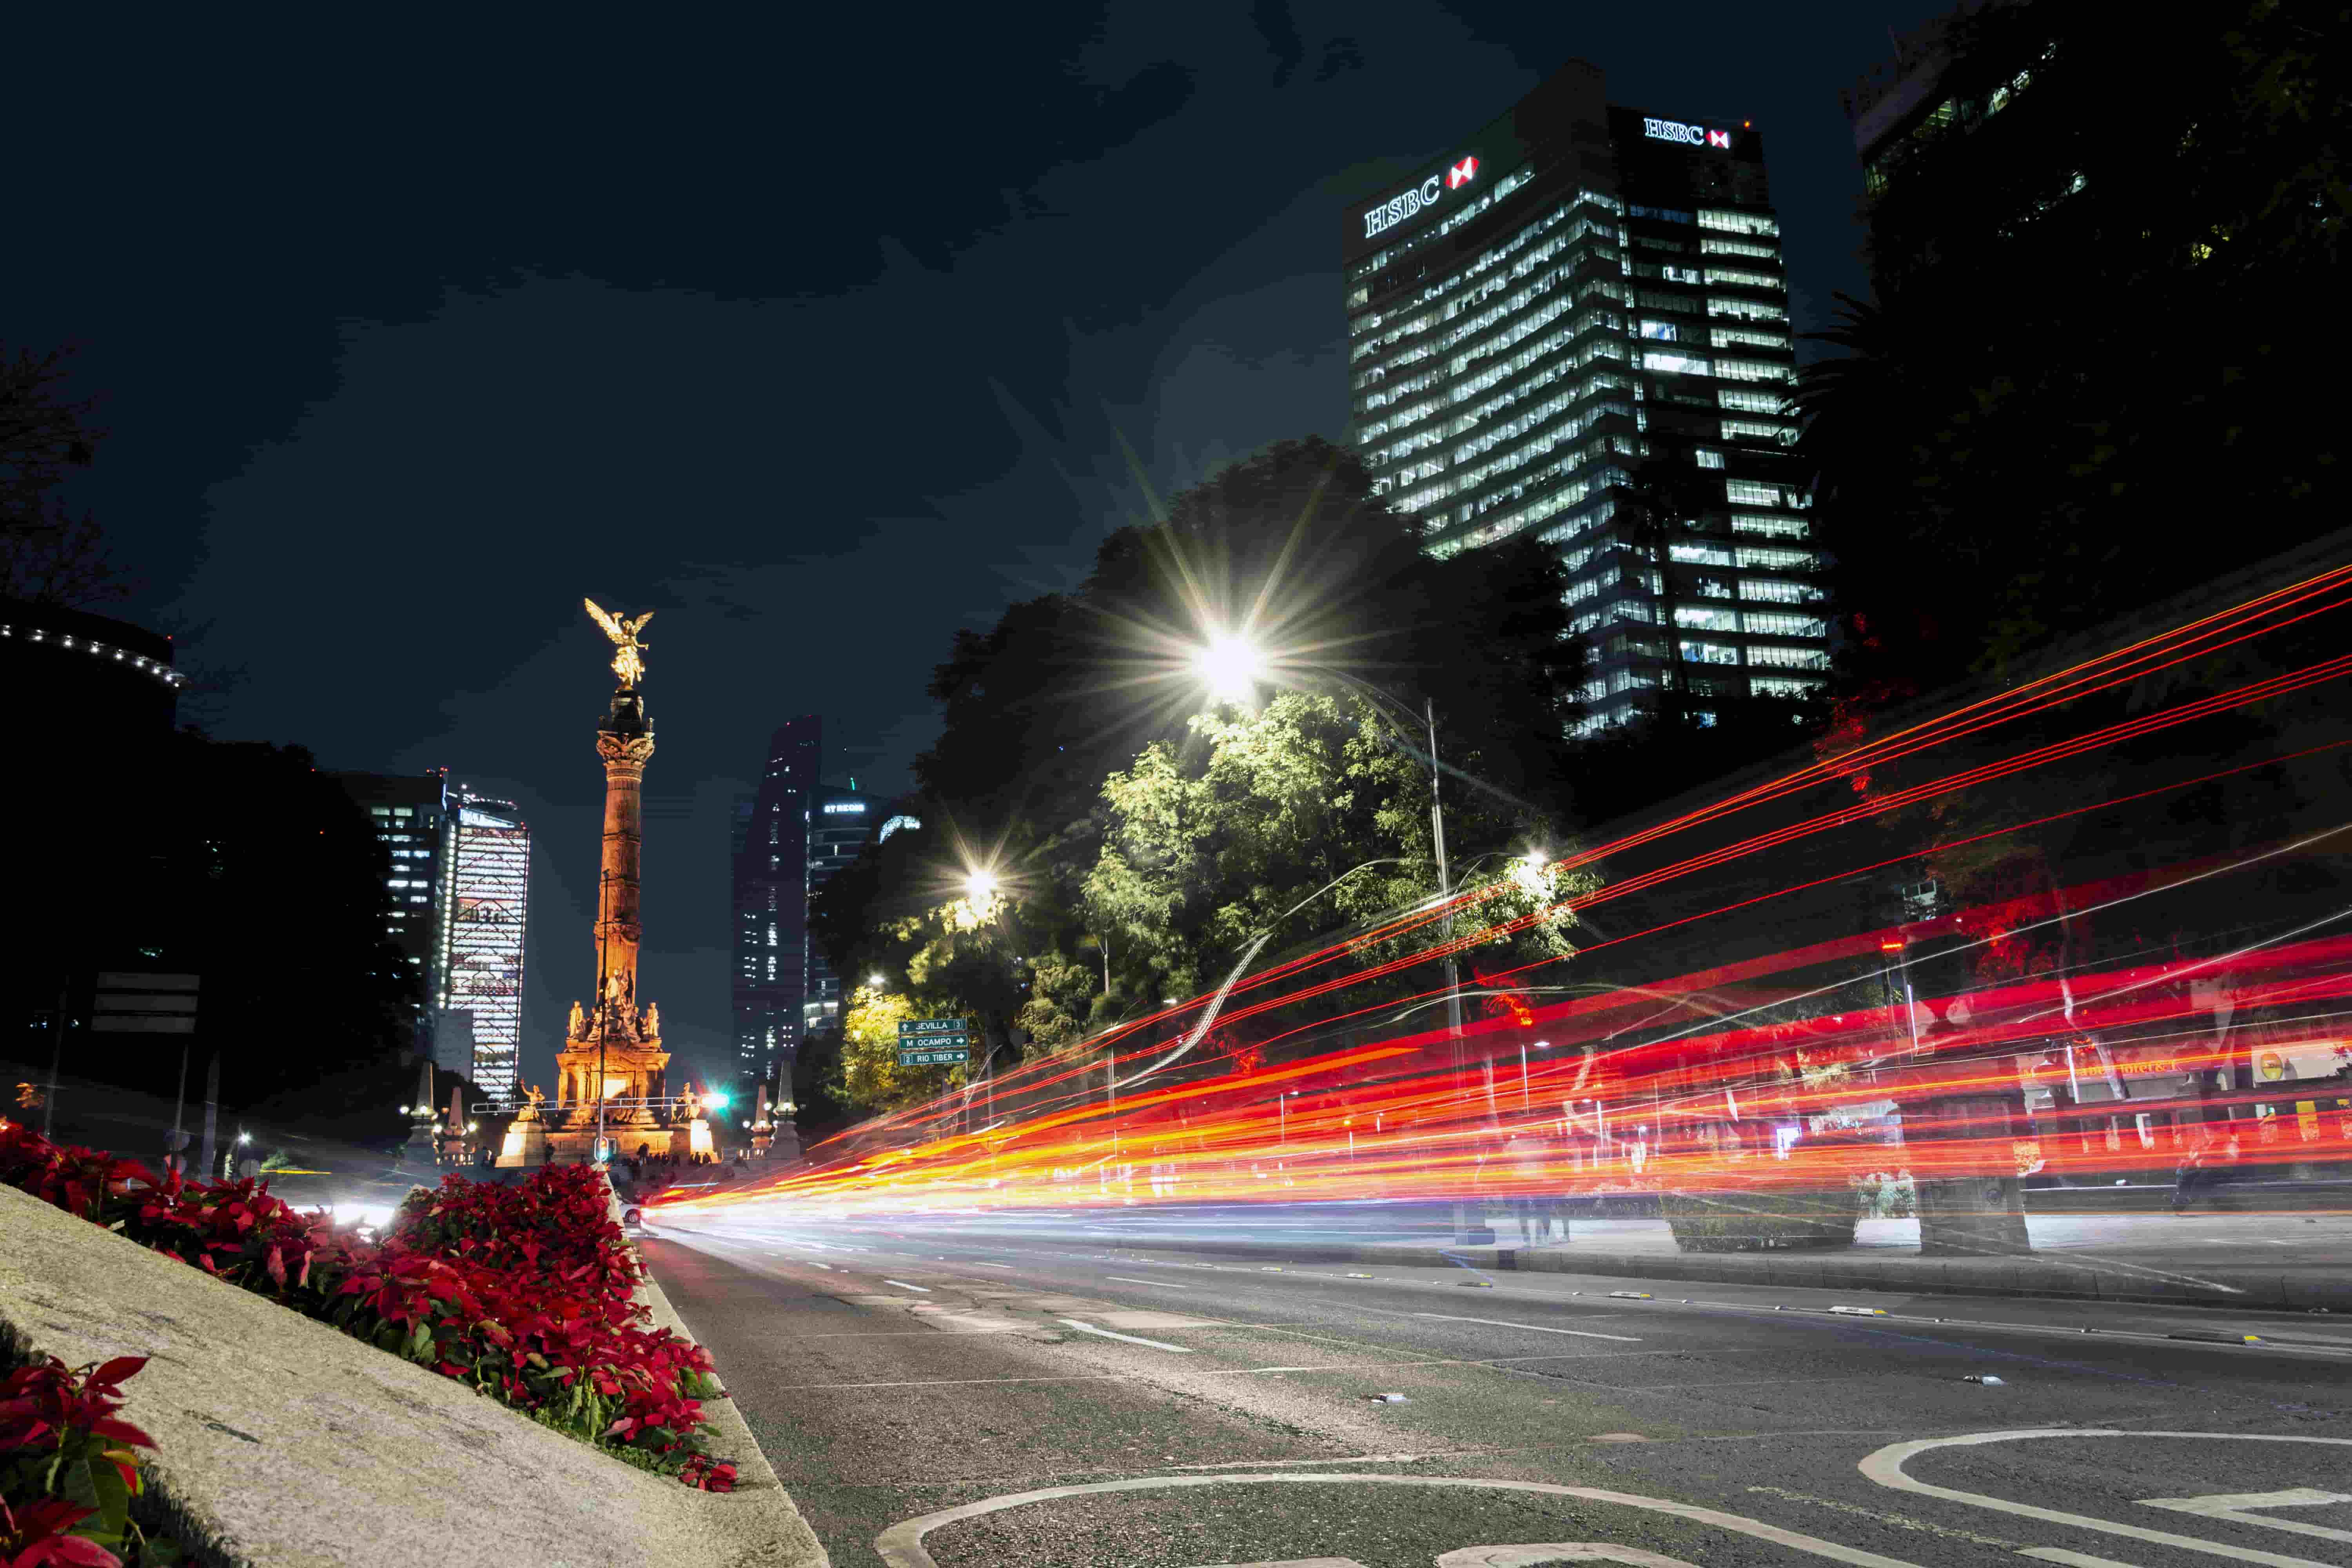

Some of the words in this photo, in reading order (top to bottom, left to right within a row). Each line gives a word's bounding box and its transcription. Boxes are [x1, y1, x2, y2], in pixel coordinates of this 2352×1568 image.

[1644, 118, 1704, 145] HSBC
[1364, 174, 1440, 239] HSBC
[918, 1038, 951, 1046] OCAMPO
